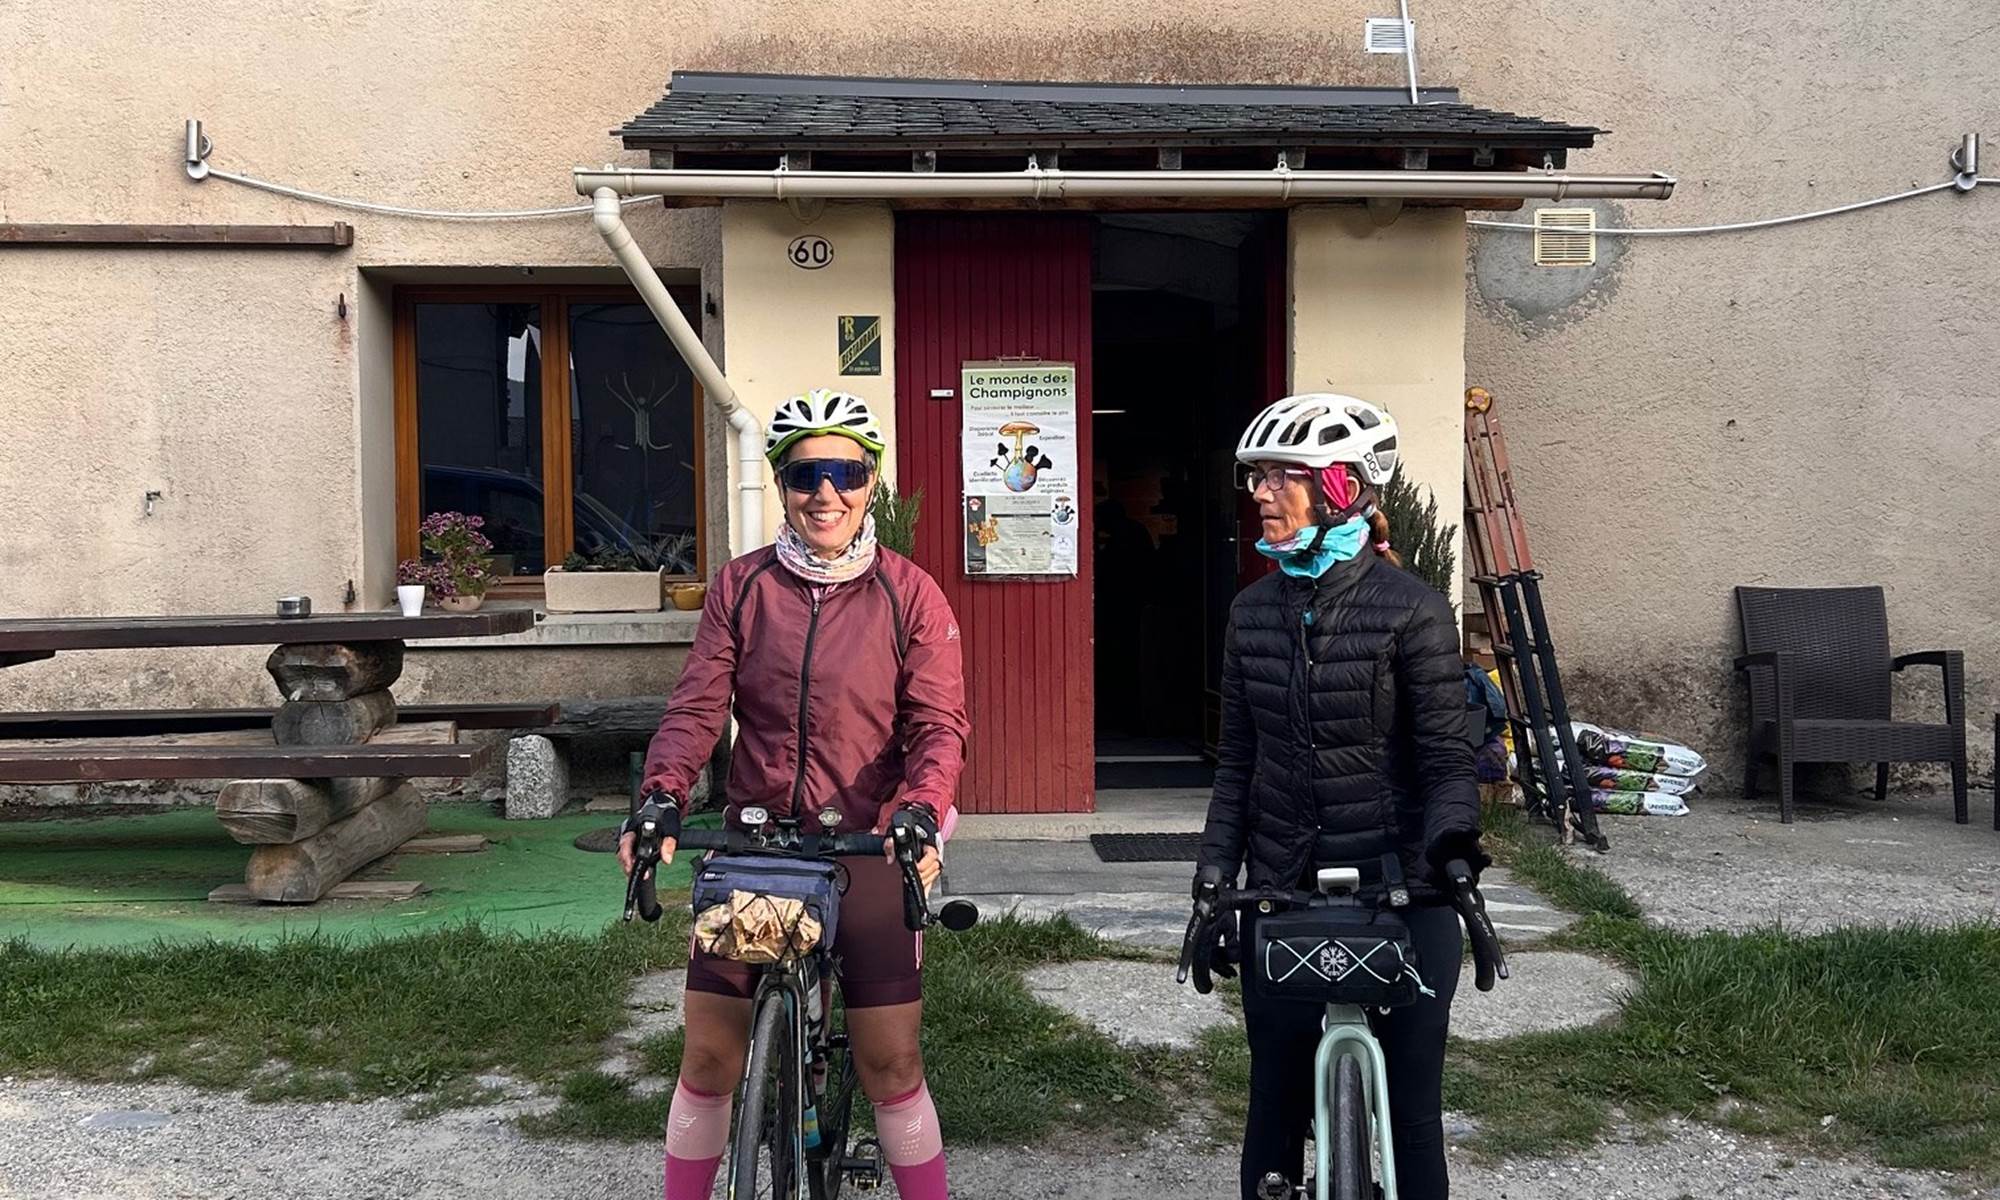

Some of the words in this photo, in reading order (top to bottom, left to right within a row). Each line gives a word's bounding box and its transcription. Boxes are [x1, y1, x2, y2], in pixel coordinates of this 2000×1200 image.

[794, 240, 828, 264] 60
[970, 375, 985, 385] Le
[989, 374, 1038, 384] monde
[1043, 373, 1068, 384] des
[969, 386, 1068, 400] Champignons
[1363, 451, 1380, 480] POC
